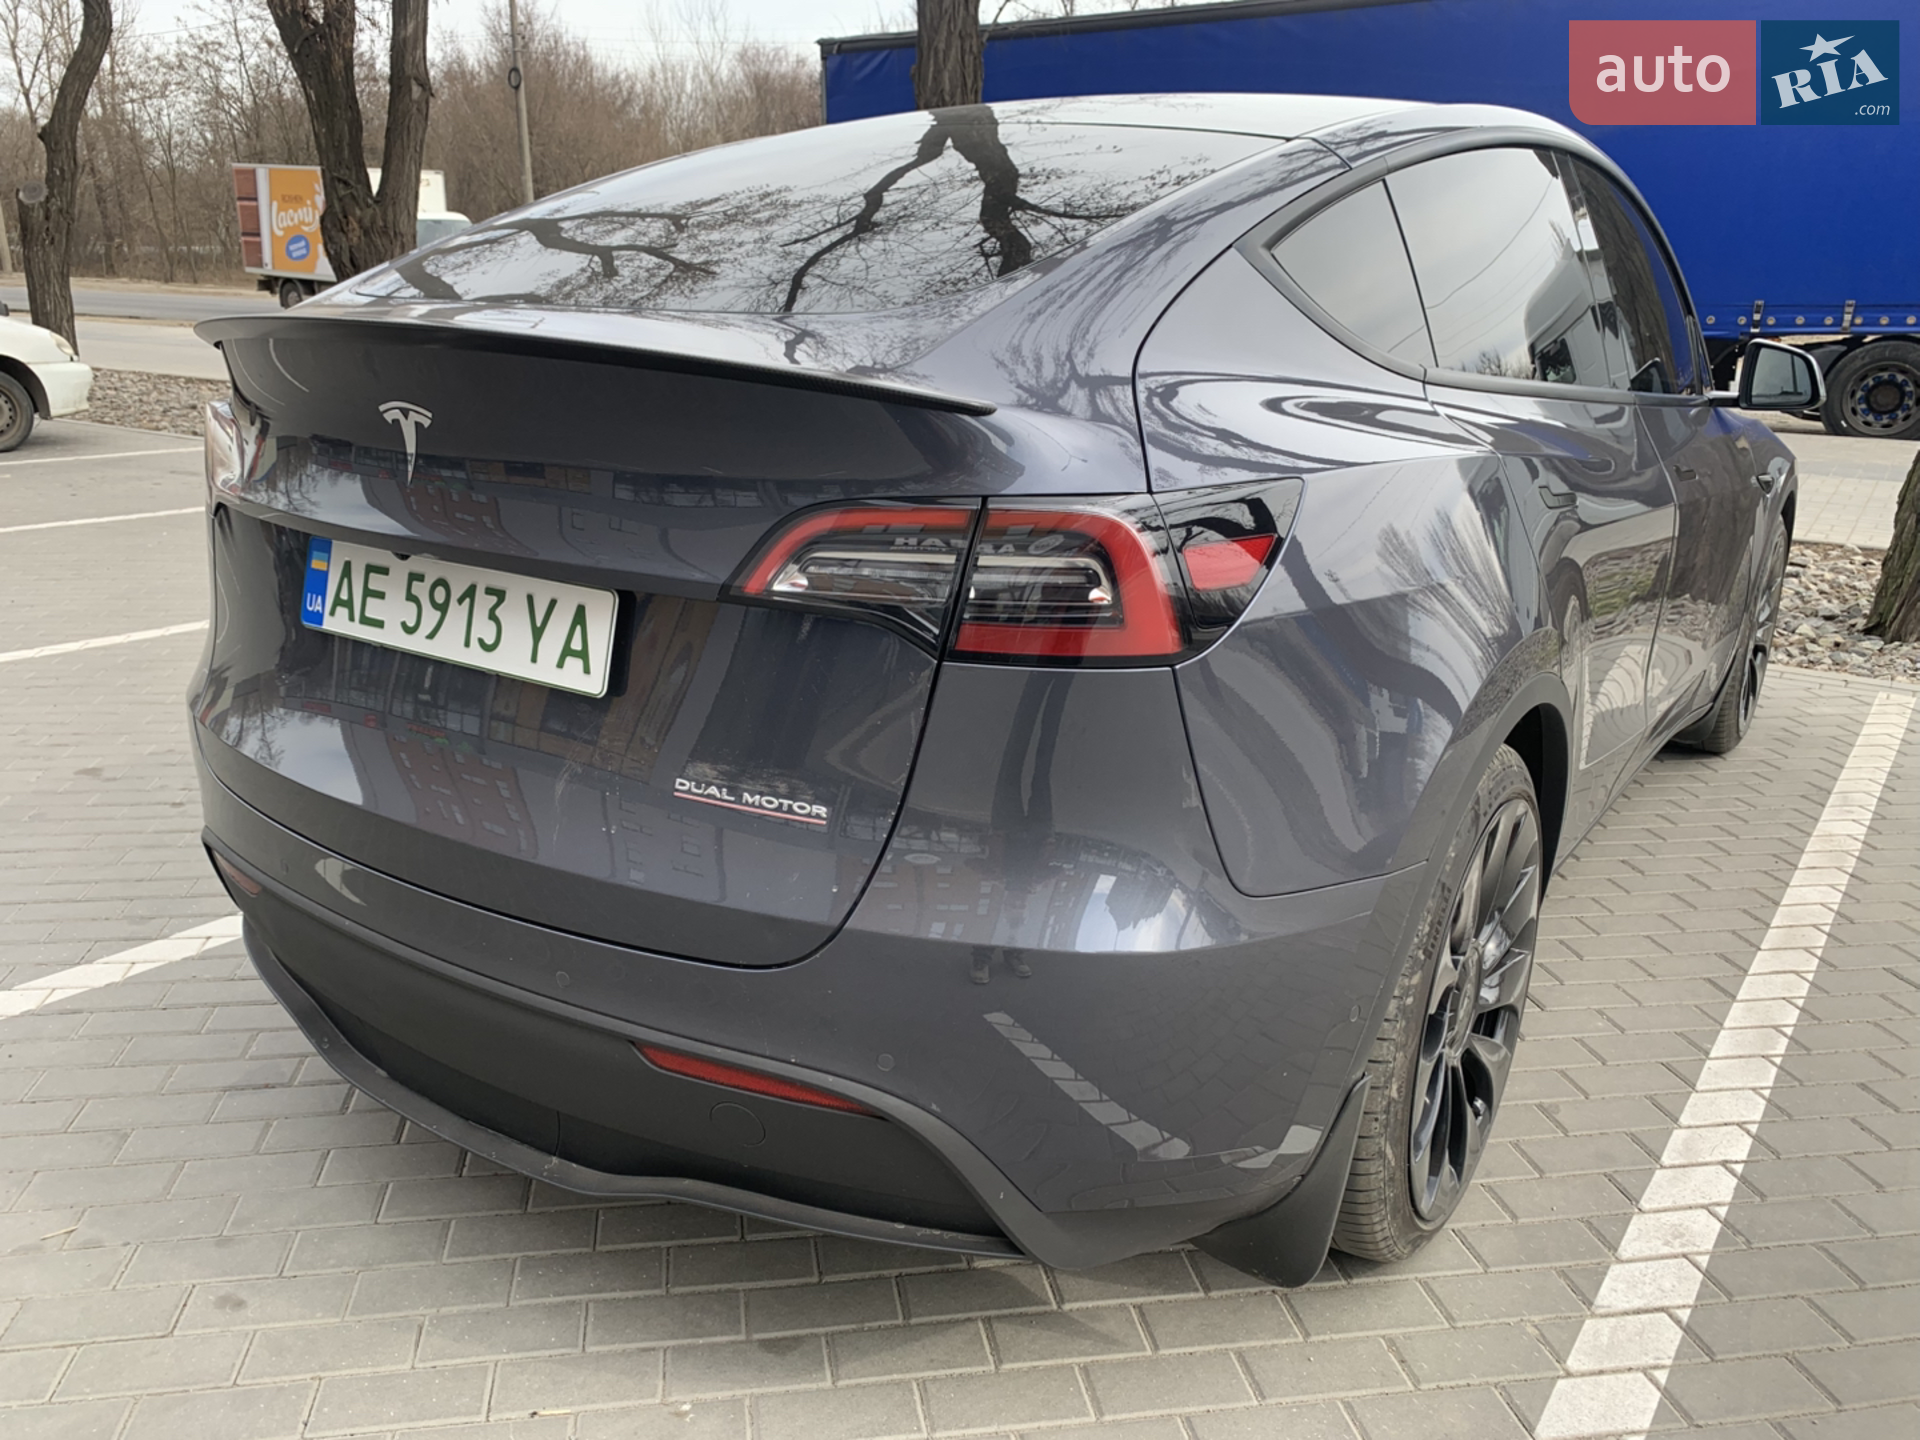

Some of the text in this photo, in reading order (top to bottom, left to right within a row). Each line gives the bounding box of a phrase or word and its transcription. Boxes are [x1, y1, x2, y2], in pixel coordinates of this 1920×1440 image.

[306, 592, 323, 614] UA
[328, 559, 592, 675] AE 5913 YA
[674, 778, 828, 818] DUAL MOTOR
